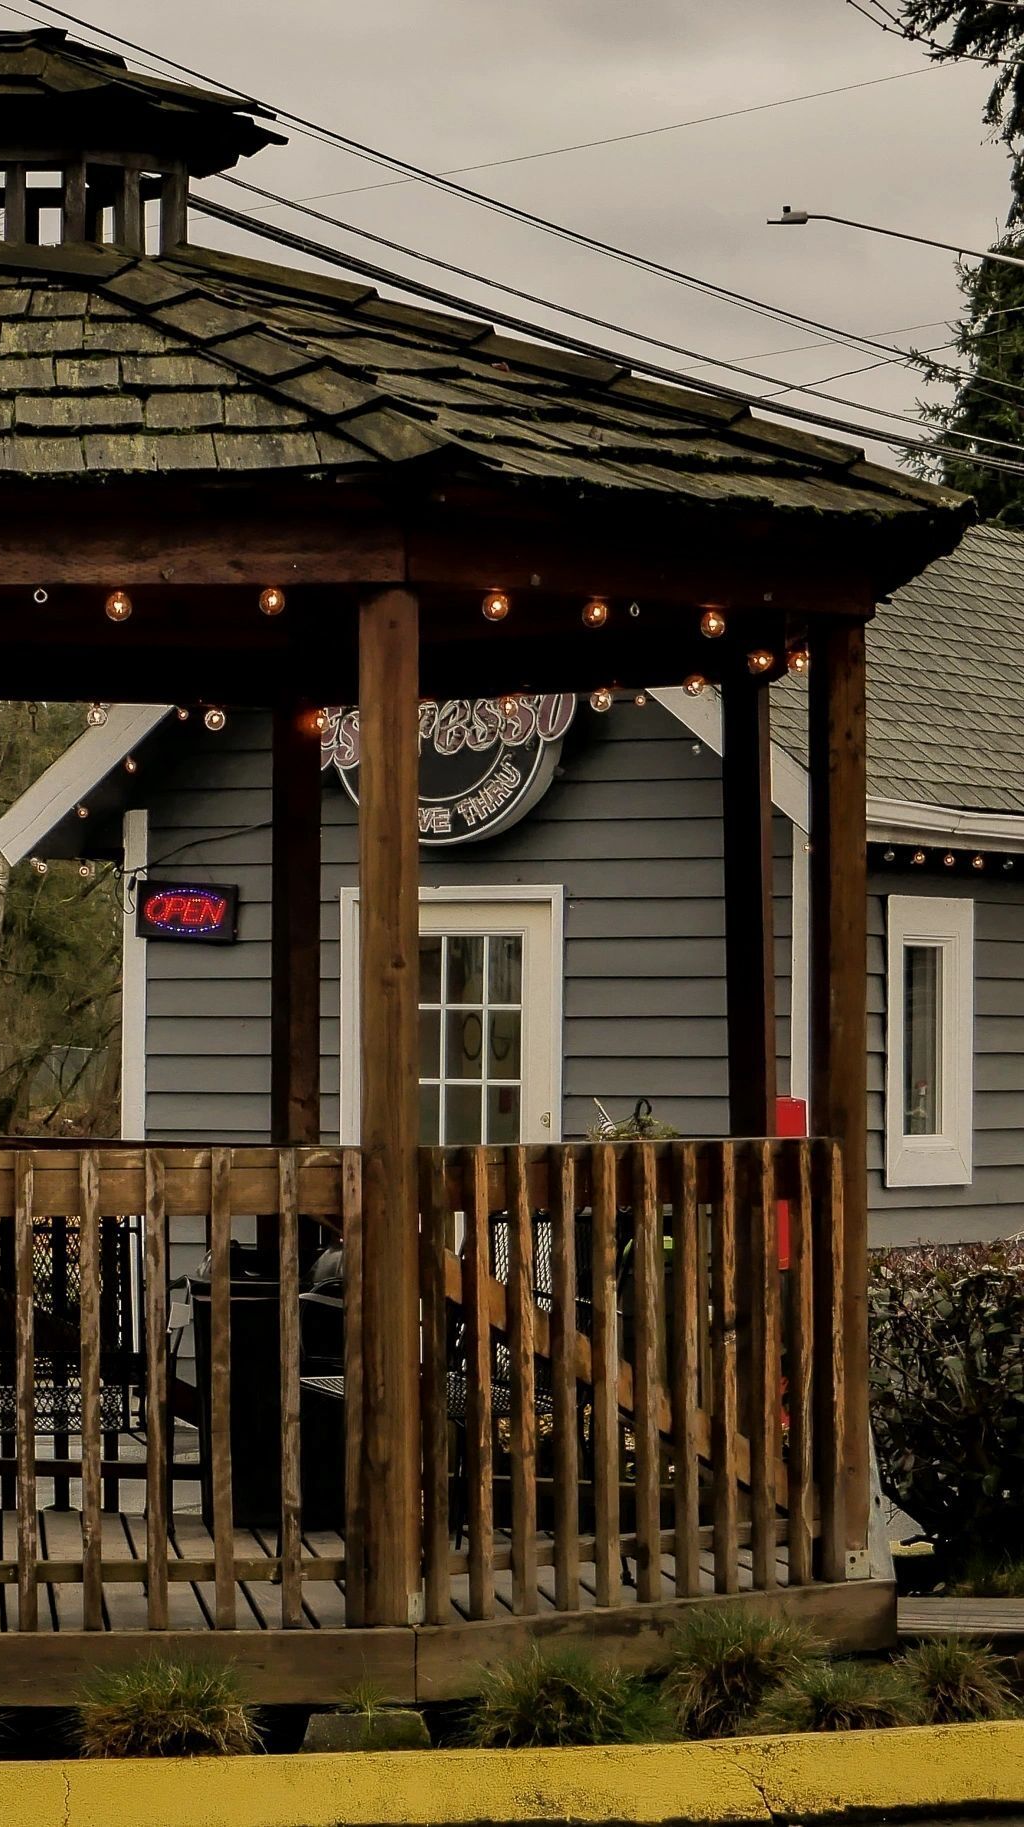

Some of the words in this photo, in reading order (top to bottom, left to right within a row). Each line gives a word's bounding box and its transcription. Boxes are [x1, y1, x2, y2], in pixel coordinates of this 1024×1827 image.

[321, 692, 576, 770] SESSO
[457, 753, 521, 826] THRU
[144, 896, 226, 925] OPEN
